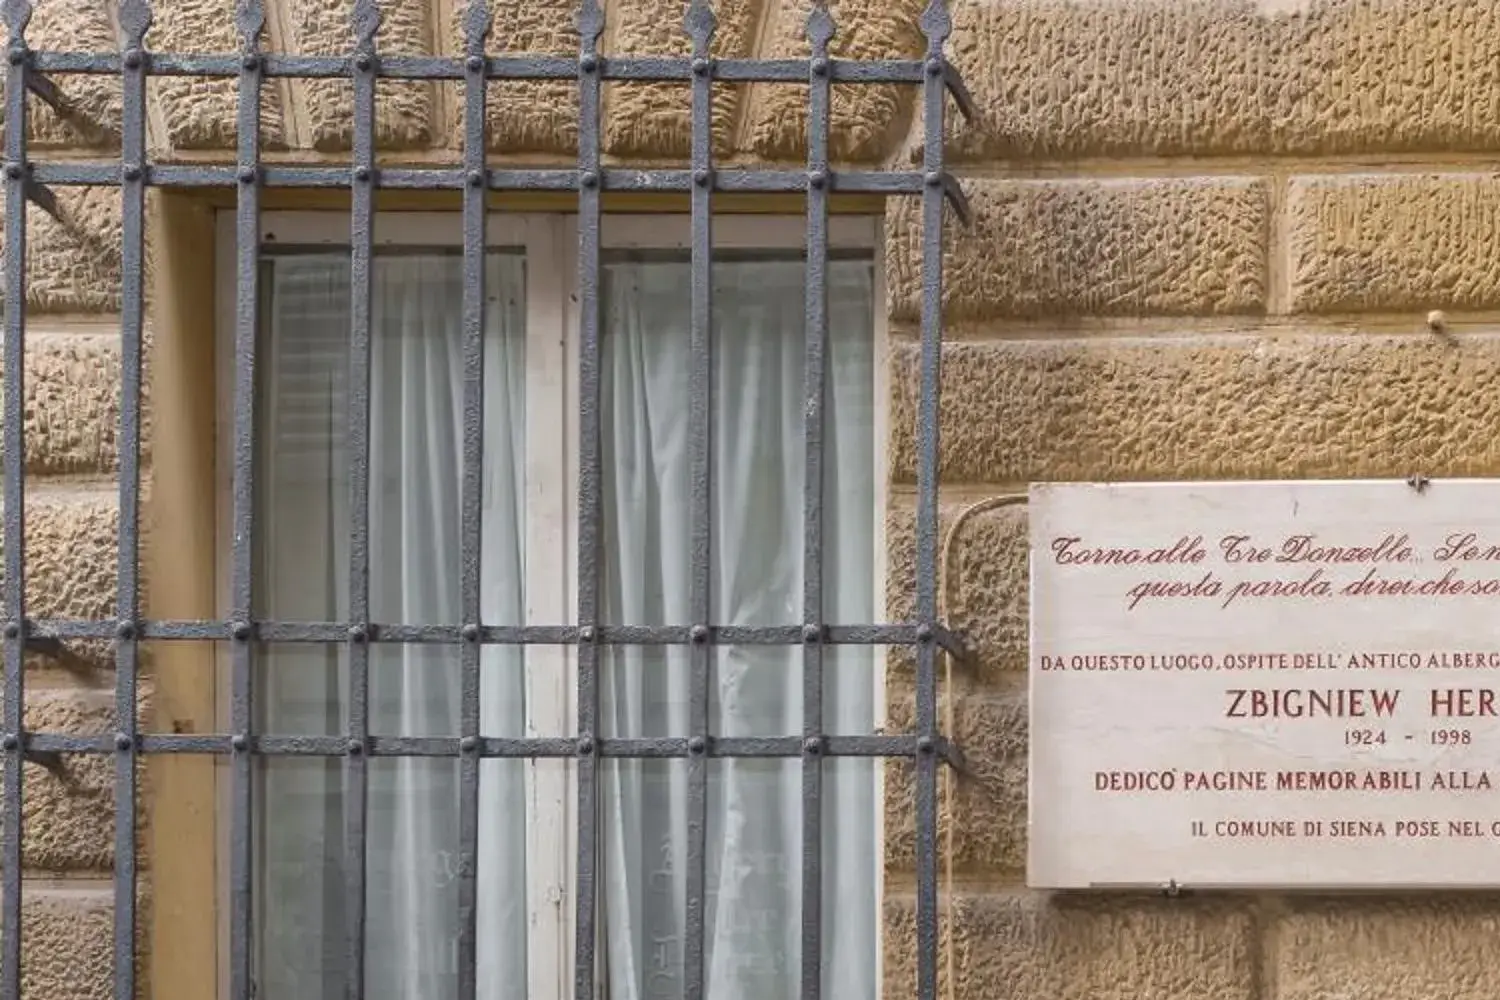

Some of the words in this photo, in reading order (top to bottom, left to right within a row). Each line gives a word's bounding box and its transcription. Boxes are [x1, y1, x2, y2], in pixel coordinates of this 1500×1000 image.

[1051, 537, 1141, 565] Torno
[1141, 535, 1207, 564] alle
[1219, 535, 1272, 563] Tre
[1434, 533, 1478, 562] Se
[1126, 571, 1222, 611] questa
[1413, 567, 1465, 596] che
[1041, 654, 1066, 671] DA
[1071, 654, 1146, 671] QUESTO
[1223, 653, 1288, 670] OSPITE
[1293, 652, 1341, 669] DELL'
[1347, 652, 1421, 669] ANTICO
[1225, 689, 1402, 718] ZBIGNIEW
[1344, 730, 1387, 745] 1924
[1430, 729, 1472, 745] 1998
[1184, 772, 1268, 791] PAGINE
[1276, 771, 1422, 791] MEMORABILI
[1431, 771, 1492, 790] ALLA
[1191, 821, 1209, 837] IL
[1215, 821, 1297, 837] COMUNE
[1304, 821, 1323, 837] DI
[1329, 821, 1386, 837] SIENA
[1395, 821, 1441, 837] POSE
[1448, 821, 1485, 837] NEL
